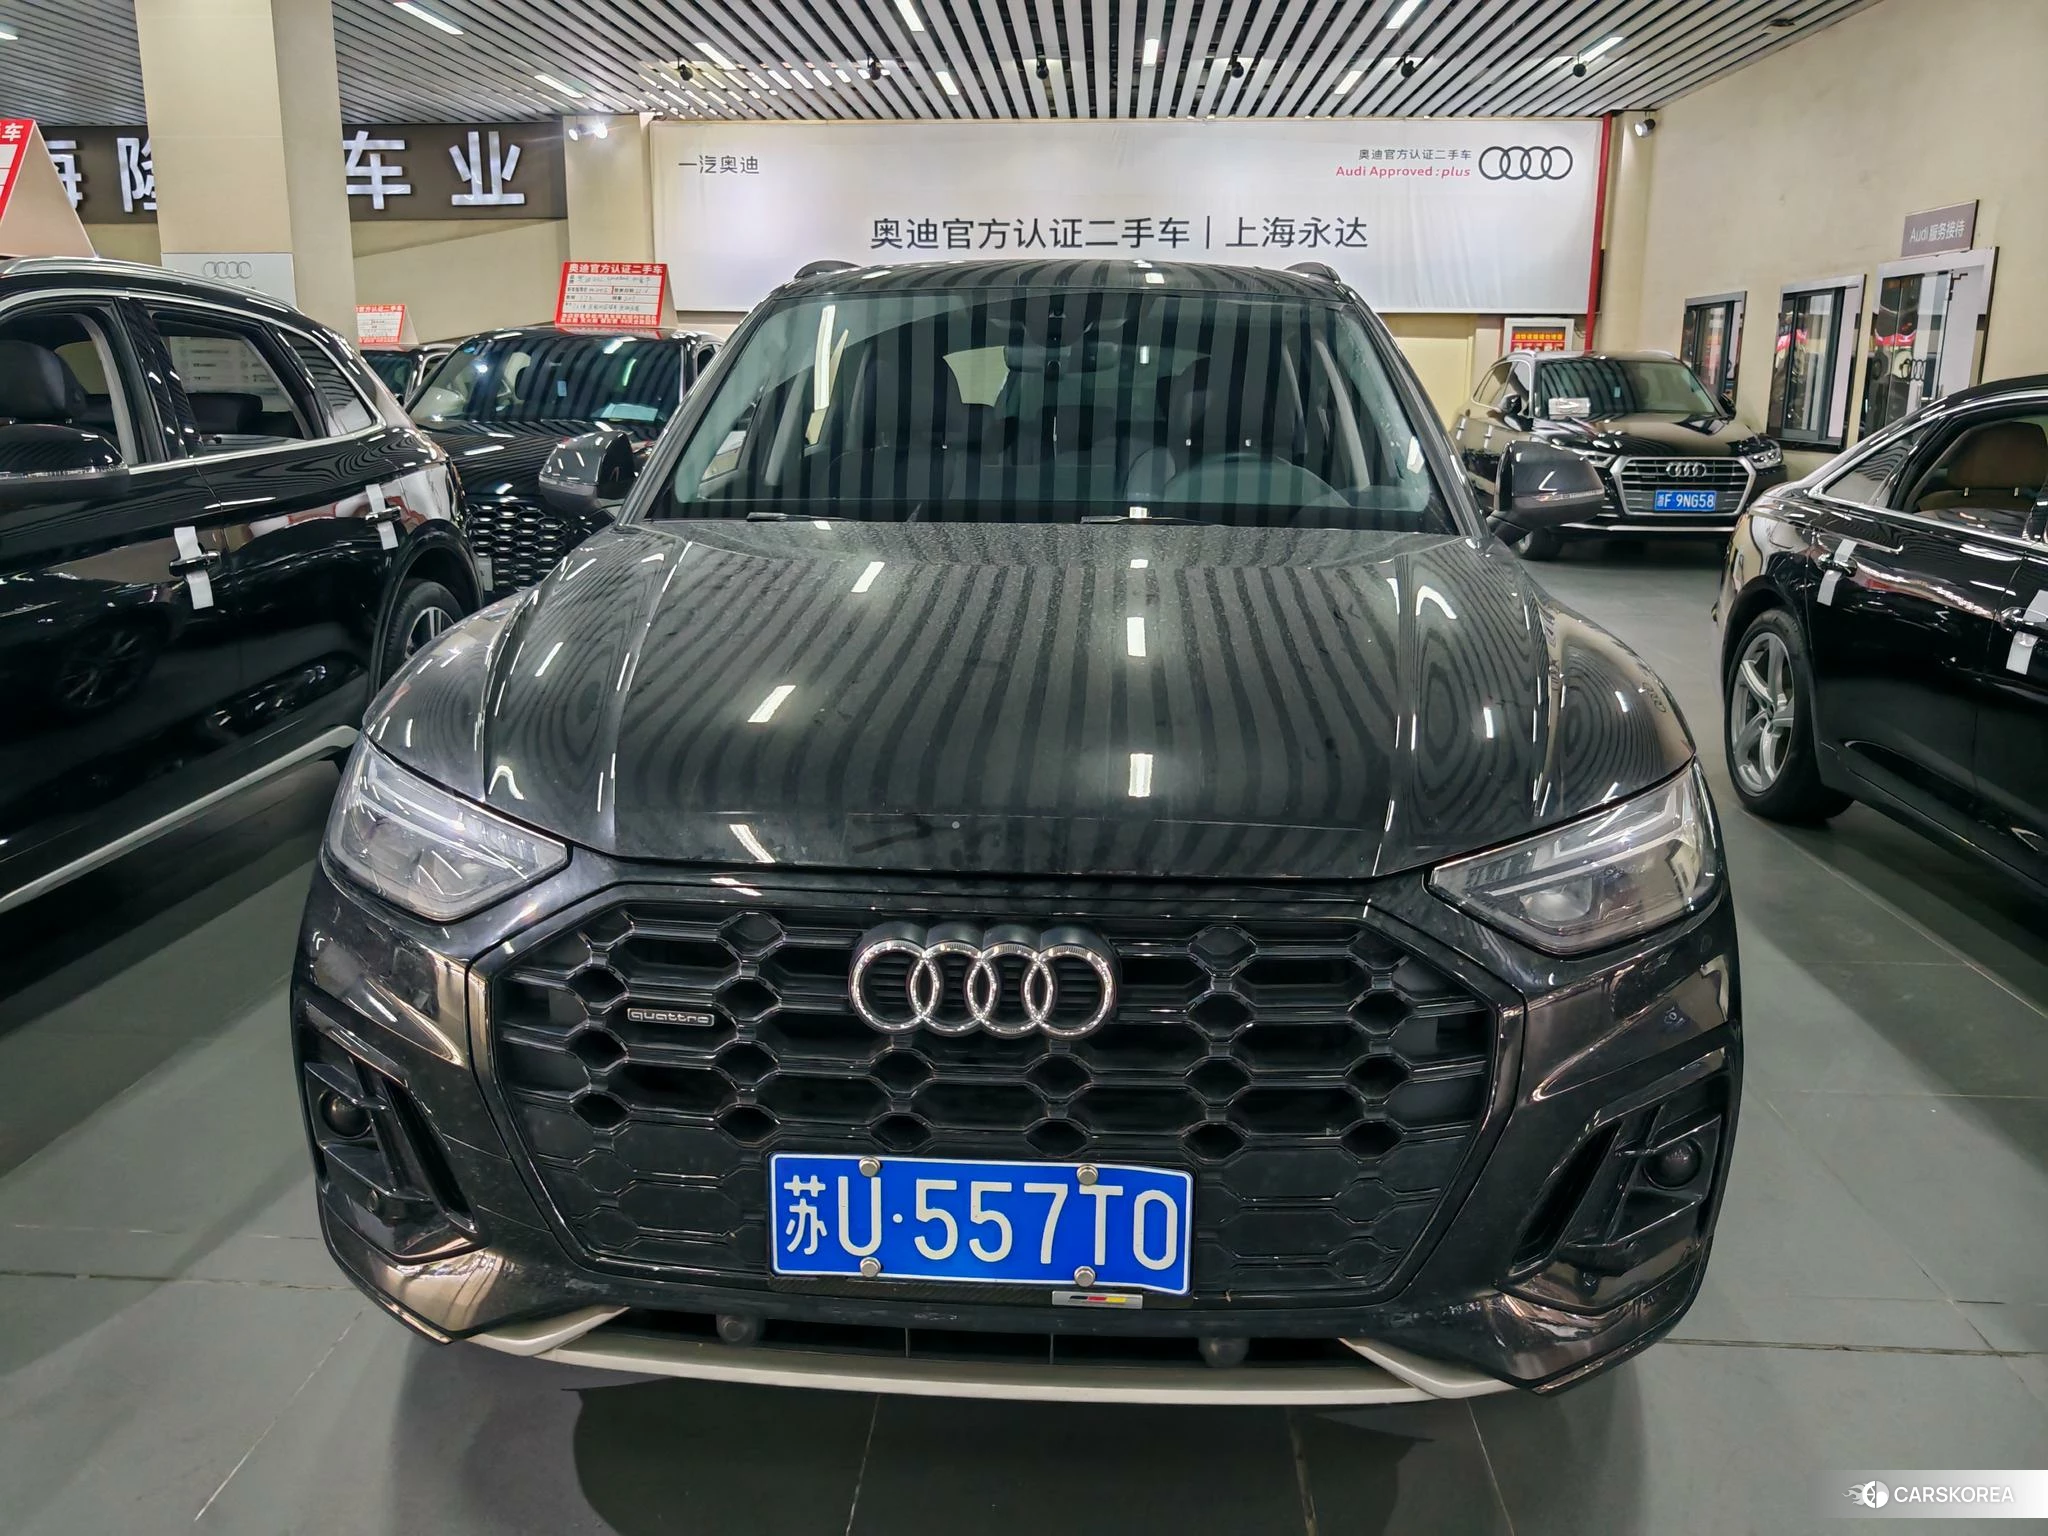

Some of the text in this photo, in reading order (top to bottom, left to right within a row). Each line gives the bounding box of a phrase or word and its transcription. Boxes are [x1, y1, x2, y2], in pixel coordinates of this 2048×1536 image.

[0, 122, 24, 142] 车
[1358, 149, 1472, 161] 奥迪官方认证二手车
[678, 154, 760, 175] 一汽奥迪
[1336, 166, 1366, 177] Audi
[1369, 166, 1433, 179] Approved
[870, 217, 1191, 250] 奥迪官方认证二手车
[1225, 216, 1369, 249] 上海永达
[569, 263, 664, 275] 奥迪官方认证二手车
[631, 1011, 709, 1023] quattro
